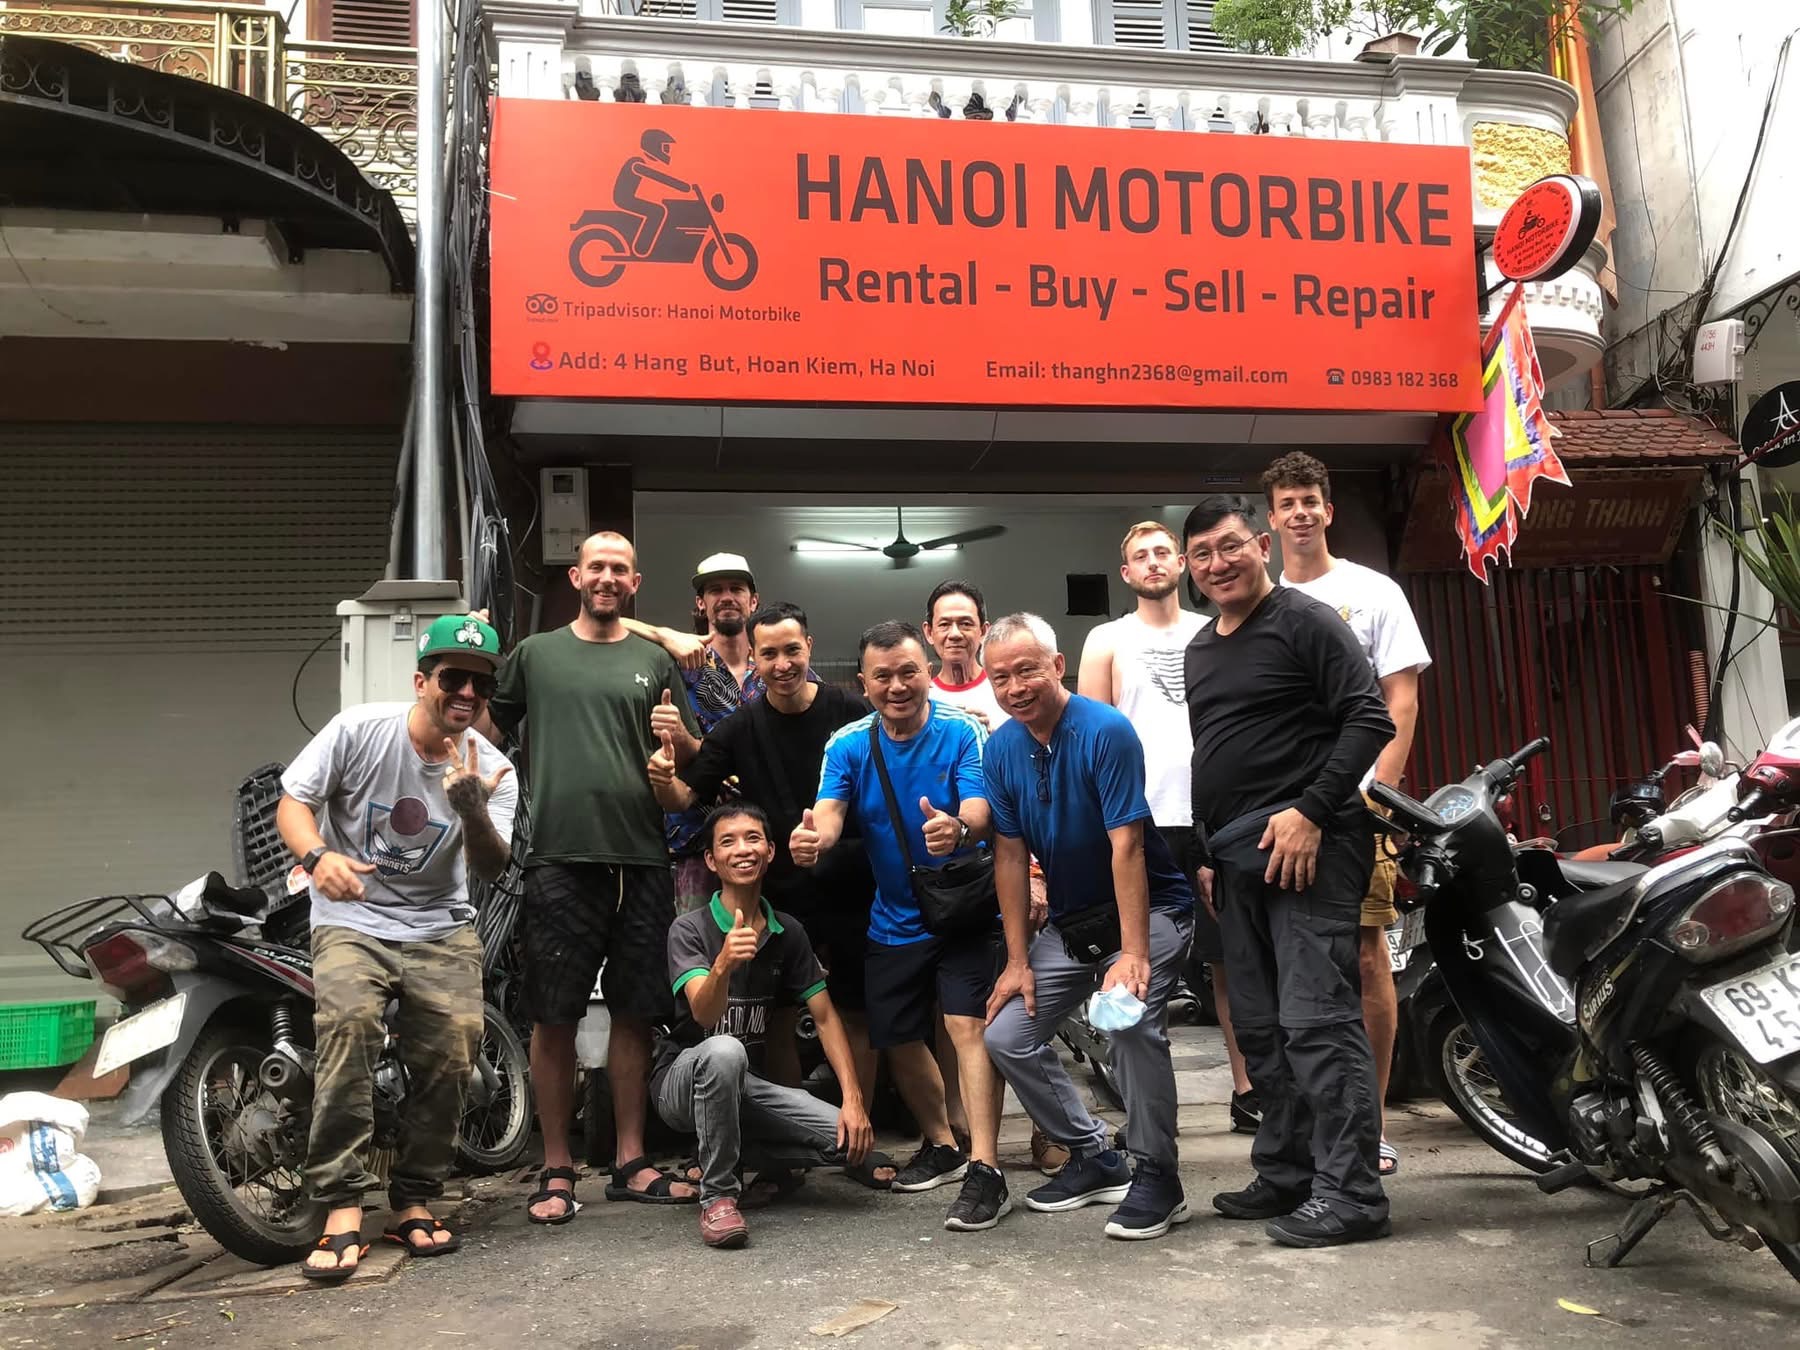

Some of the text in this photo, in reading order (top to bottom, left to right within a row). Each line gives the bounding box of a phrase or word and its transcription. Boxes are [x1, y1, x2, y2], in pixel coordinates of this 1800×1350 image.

[796, 153, 1452, 247] HANOI MOTORBIKE
[819, 257, 977, 306] Rental
[1029, 264, 1117, 321] Buy
[1164, 268, 1245, 313] Sell
[1293, 273, 1436, 330] Repair
[562, 301, 801, 325] Tripadvisor: Hanoi Motorbike
[558, 351, 935, 378] Add: 4 Hang But, Hoan Kiem, Ha Noi
[986, 360, 1288, 387] Email: thanghn2368@gmail.com
[1351, 370, 1459, 388] 0983 182 368
[371, 853, 411, 874] HORNETS
[1756, 1003, 1800, 1049] 45
